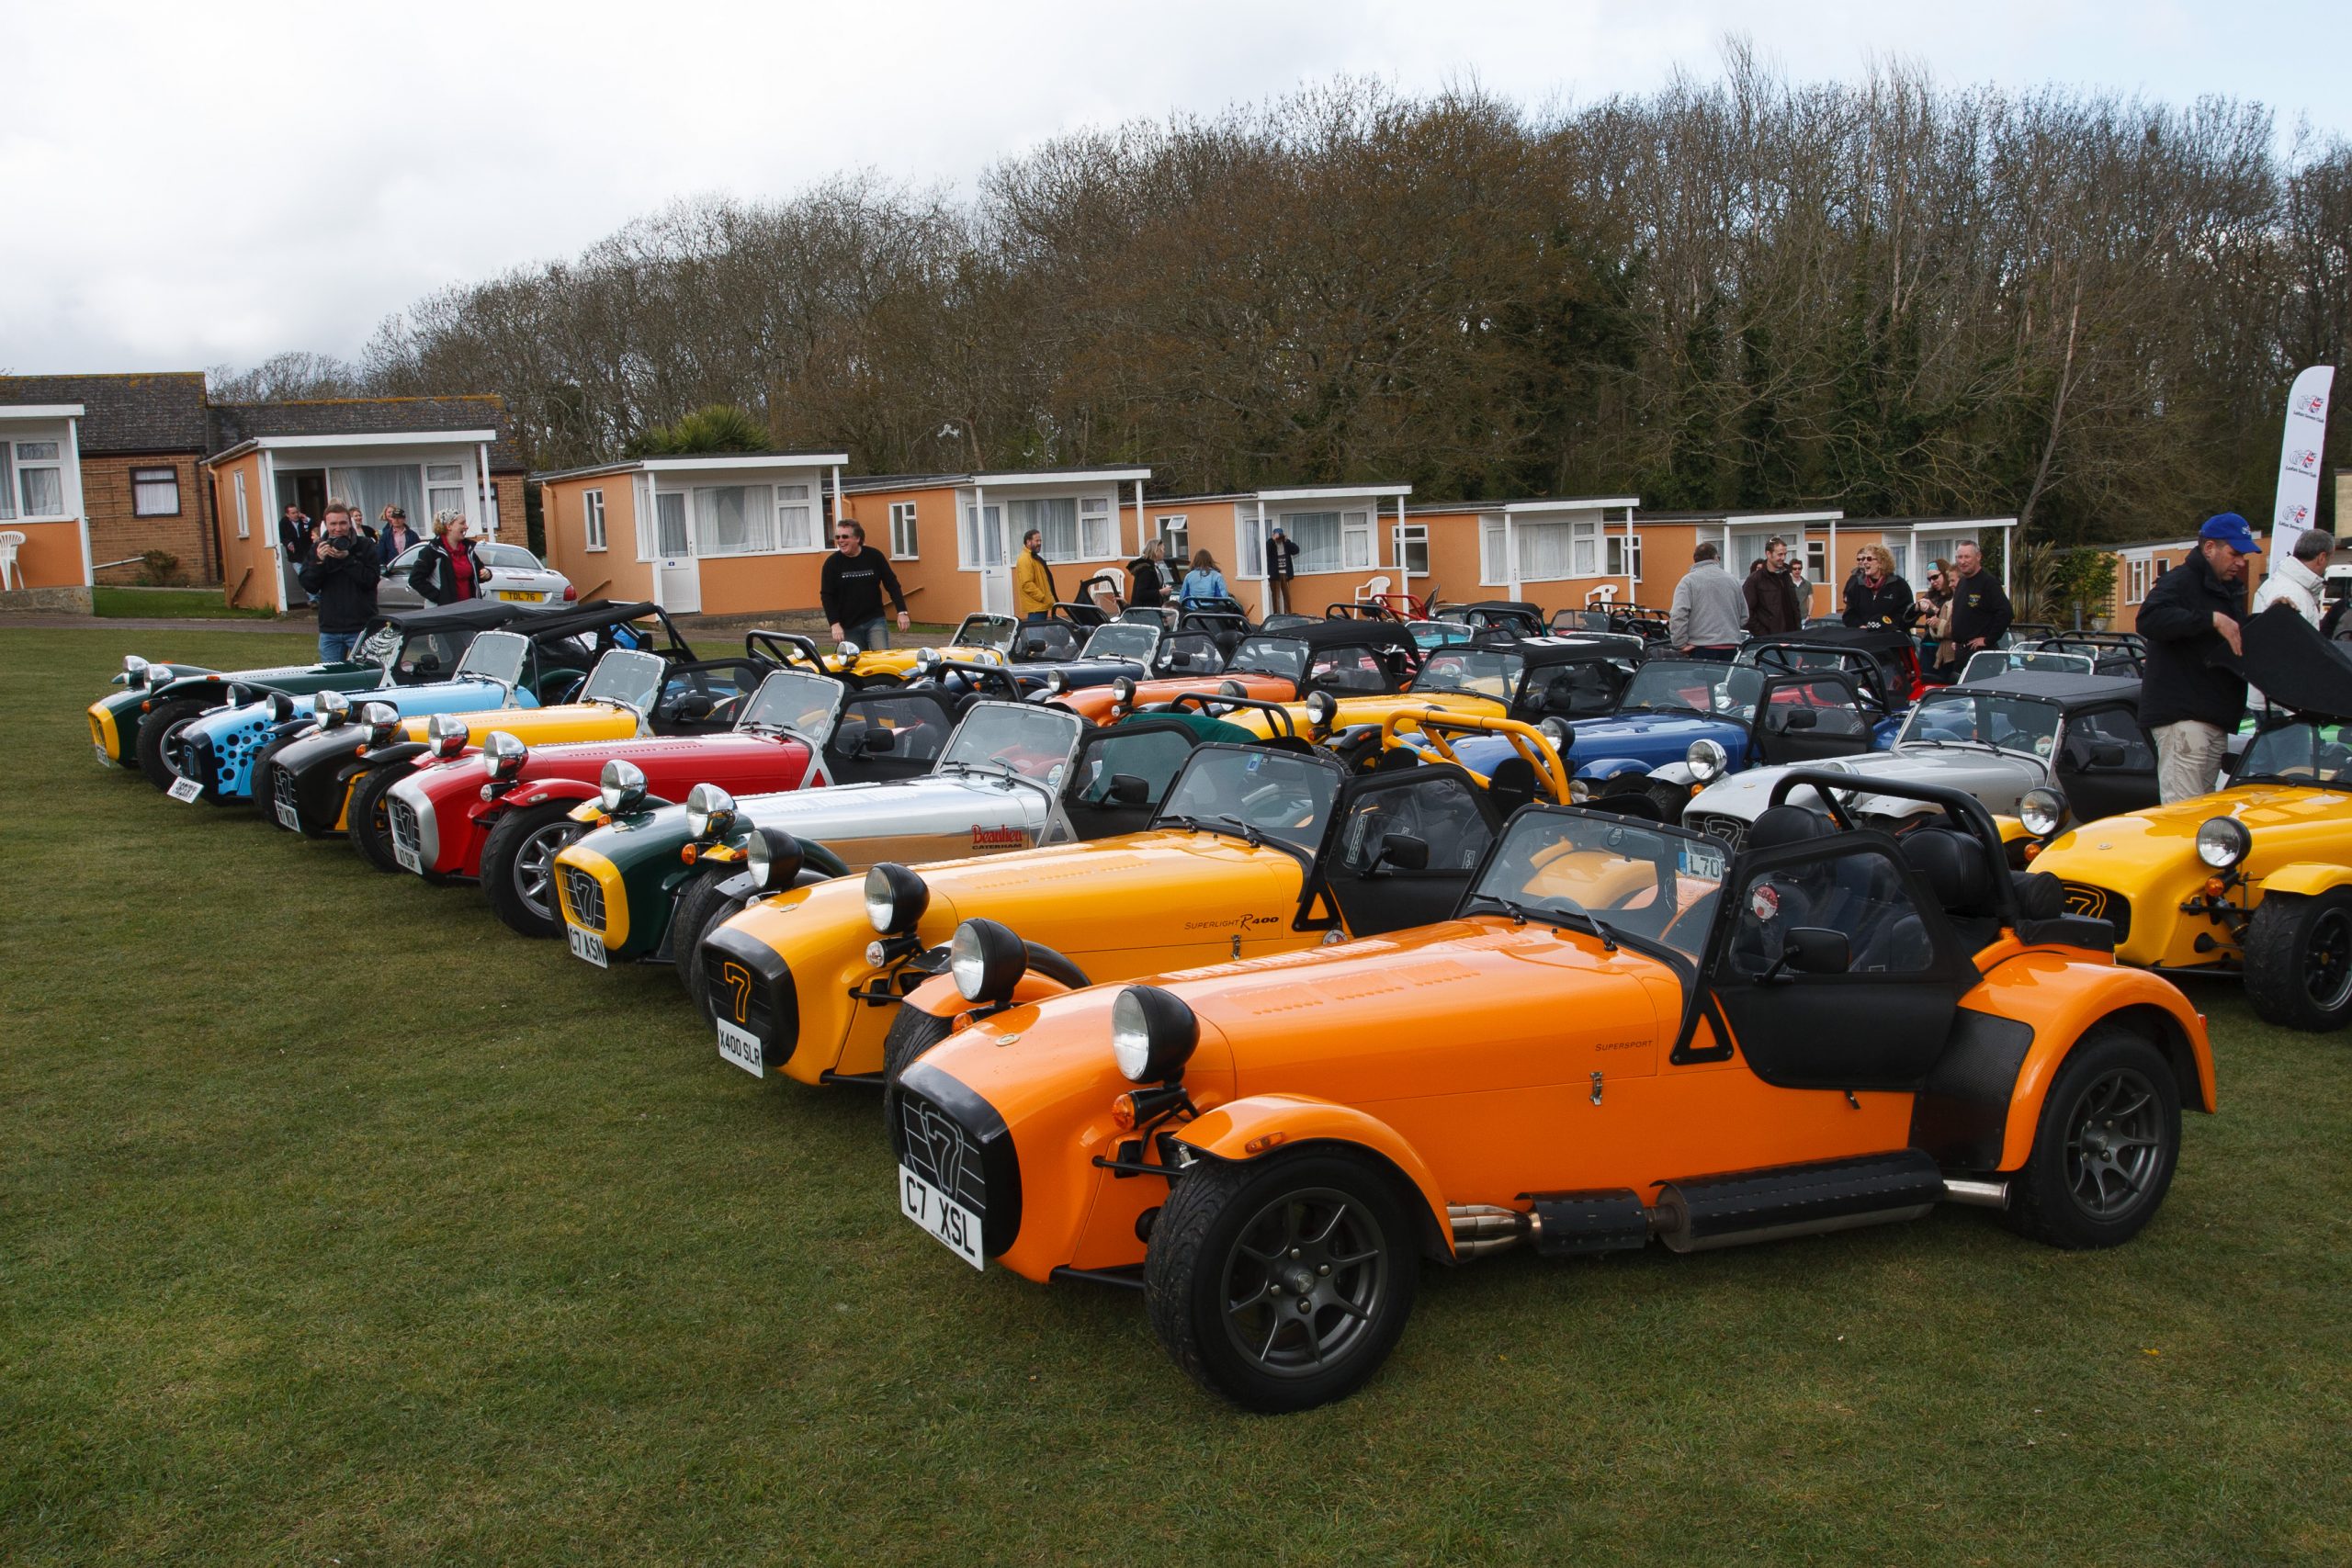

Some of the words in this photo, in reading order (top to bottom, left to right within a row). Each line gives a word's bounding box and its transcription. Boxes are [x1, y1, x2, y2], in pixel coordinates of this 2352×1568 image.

[508, 592, 524, 601] TDL
[526, 592, 536, 601] 76
[971, 823, 1023, 843] Beaulieu
[570, 928, 582, 953] C7
[584, 933, 605, 964] ASN
[724, 961, 752, 1023] 7
[718, 1028, 741, 1057] X400
[743, 1041, 761, 1068] SLR
[925, 1111, 959, 1194] 7
[906, 1174, 927, 1221] C7
[938, 1196, 976, 1258] XSL
